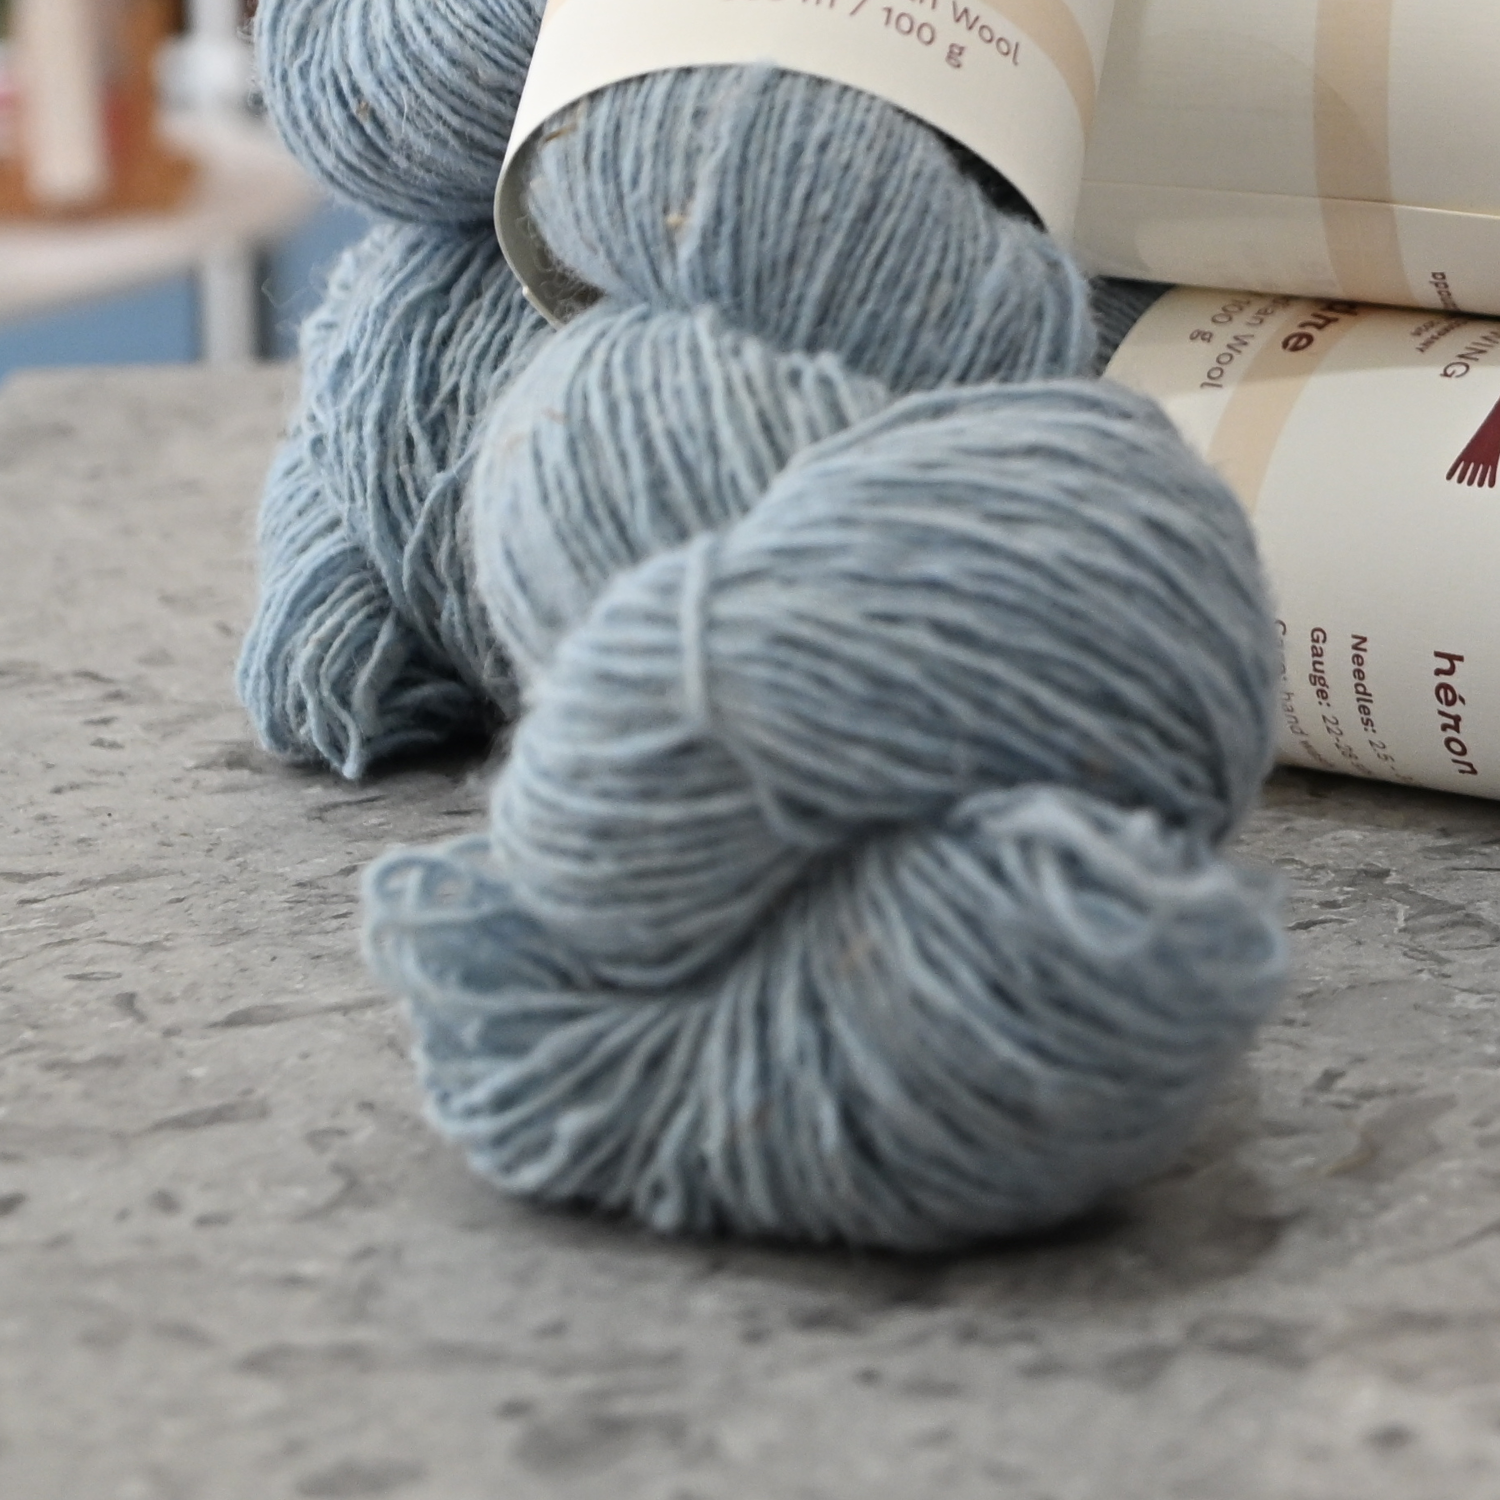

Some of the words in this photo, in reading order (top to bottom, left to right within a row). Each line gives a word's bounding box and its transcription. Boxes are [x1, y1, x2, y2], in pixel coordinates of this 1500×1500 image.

[882, 6, 936, 46] 100
[945, 42, 966, 70] g
[952, 0, 1022, 66] Wool
[1189, 329, 1213, 343] g
[1200, 333, 1254, 389] Wool
[1309, 627, 1330, 707] Gauge:
[1351, 634, 1377, 733] Needles:
[1433, 650, 1478, 776] héron
